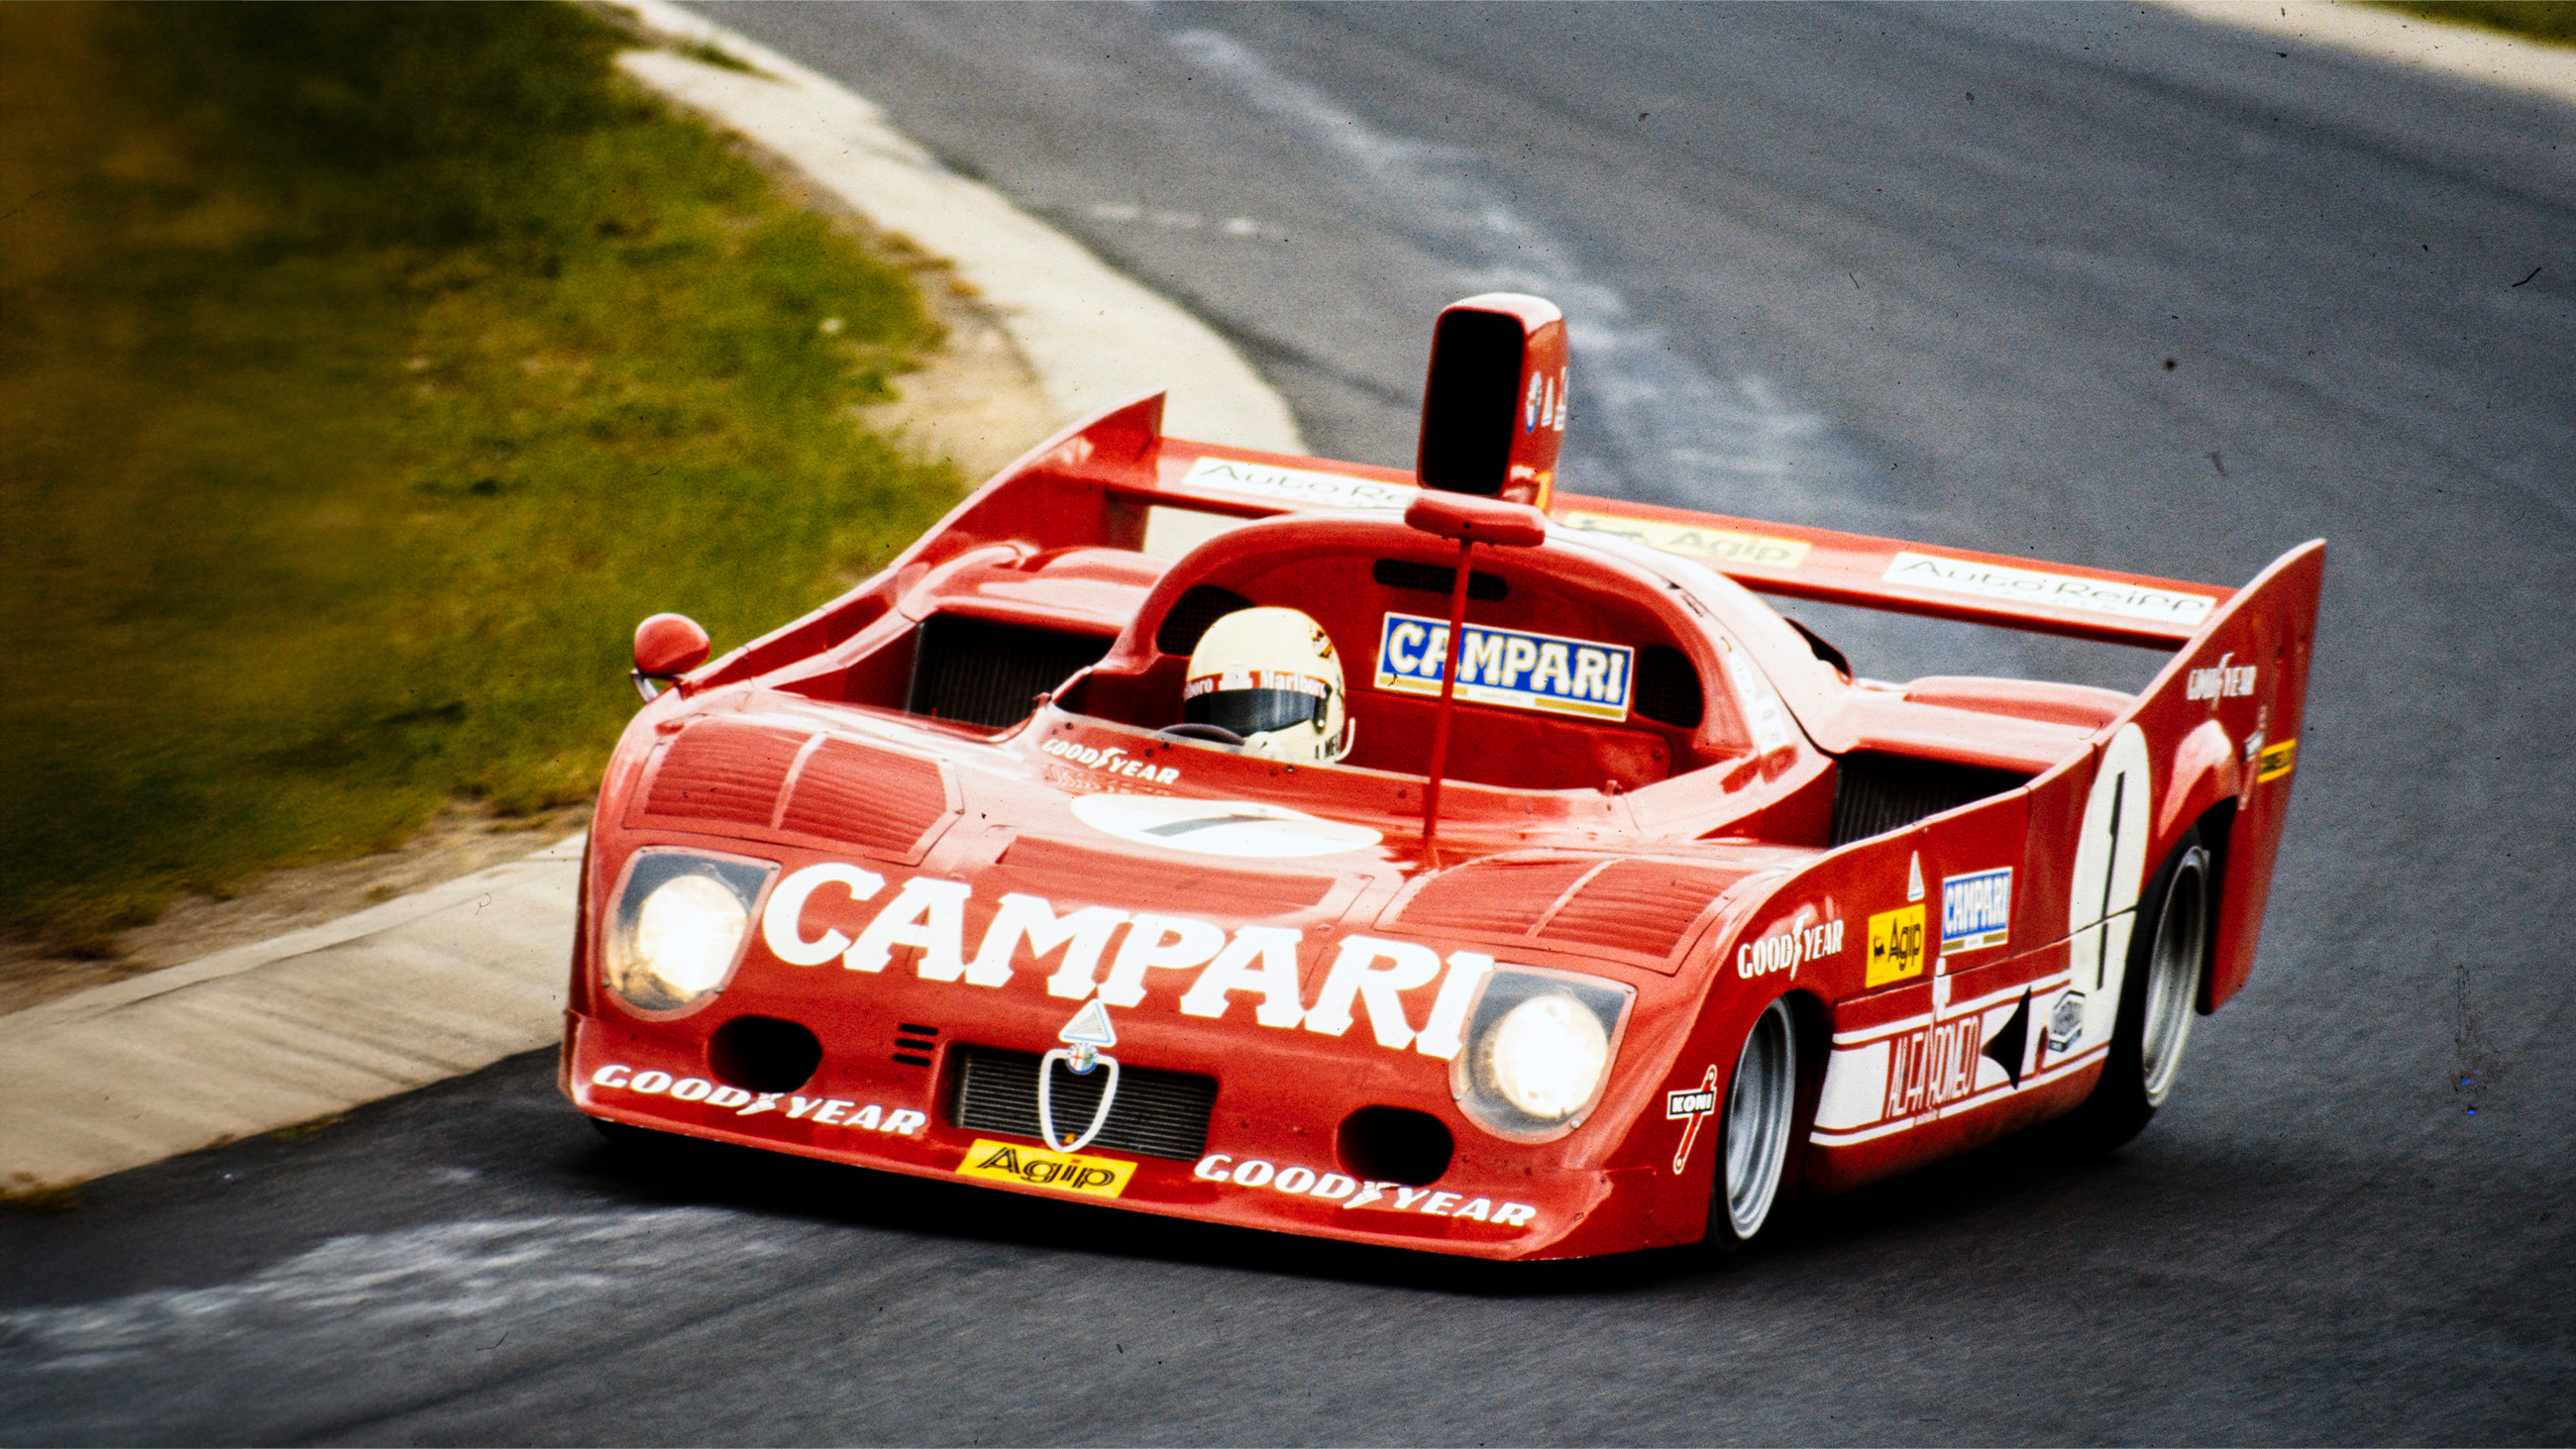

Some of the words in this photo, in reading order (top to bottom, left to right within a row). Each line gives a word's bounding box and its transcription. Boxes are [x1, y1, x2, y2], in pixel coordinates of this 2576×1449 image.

[1199, 465, 1339, 493] Auto
[1668, 531, 1791, 563] Agip
[1388, 621, 1626, 703] CAMPARI
[1944, 875, 2009, 935] CAMPARI
[2096, 770, 2126, 990] 1
[761, 862, 1495, 1061] CAMPARI
[1887, 912, 1922, 972] Agip
[1671, 1092, 1713, 1113] KONI
[975, 1146, 1116, 1190] Agip
